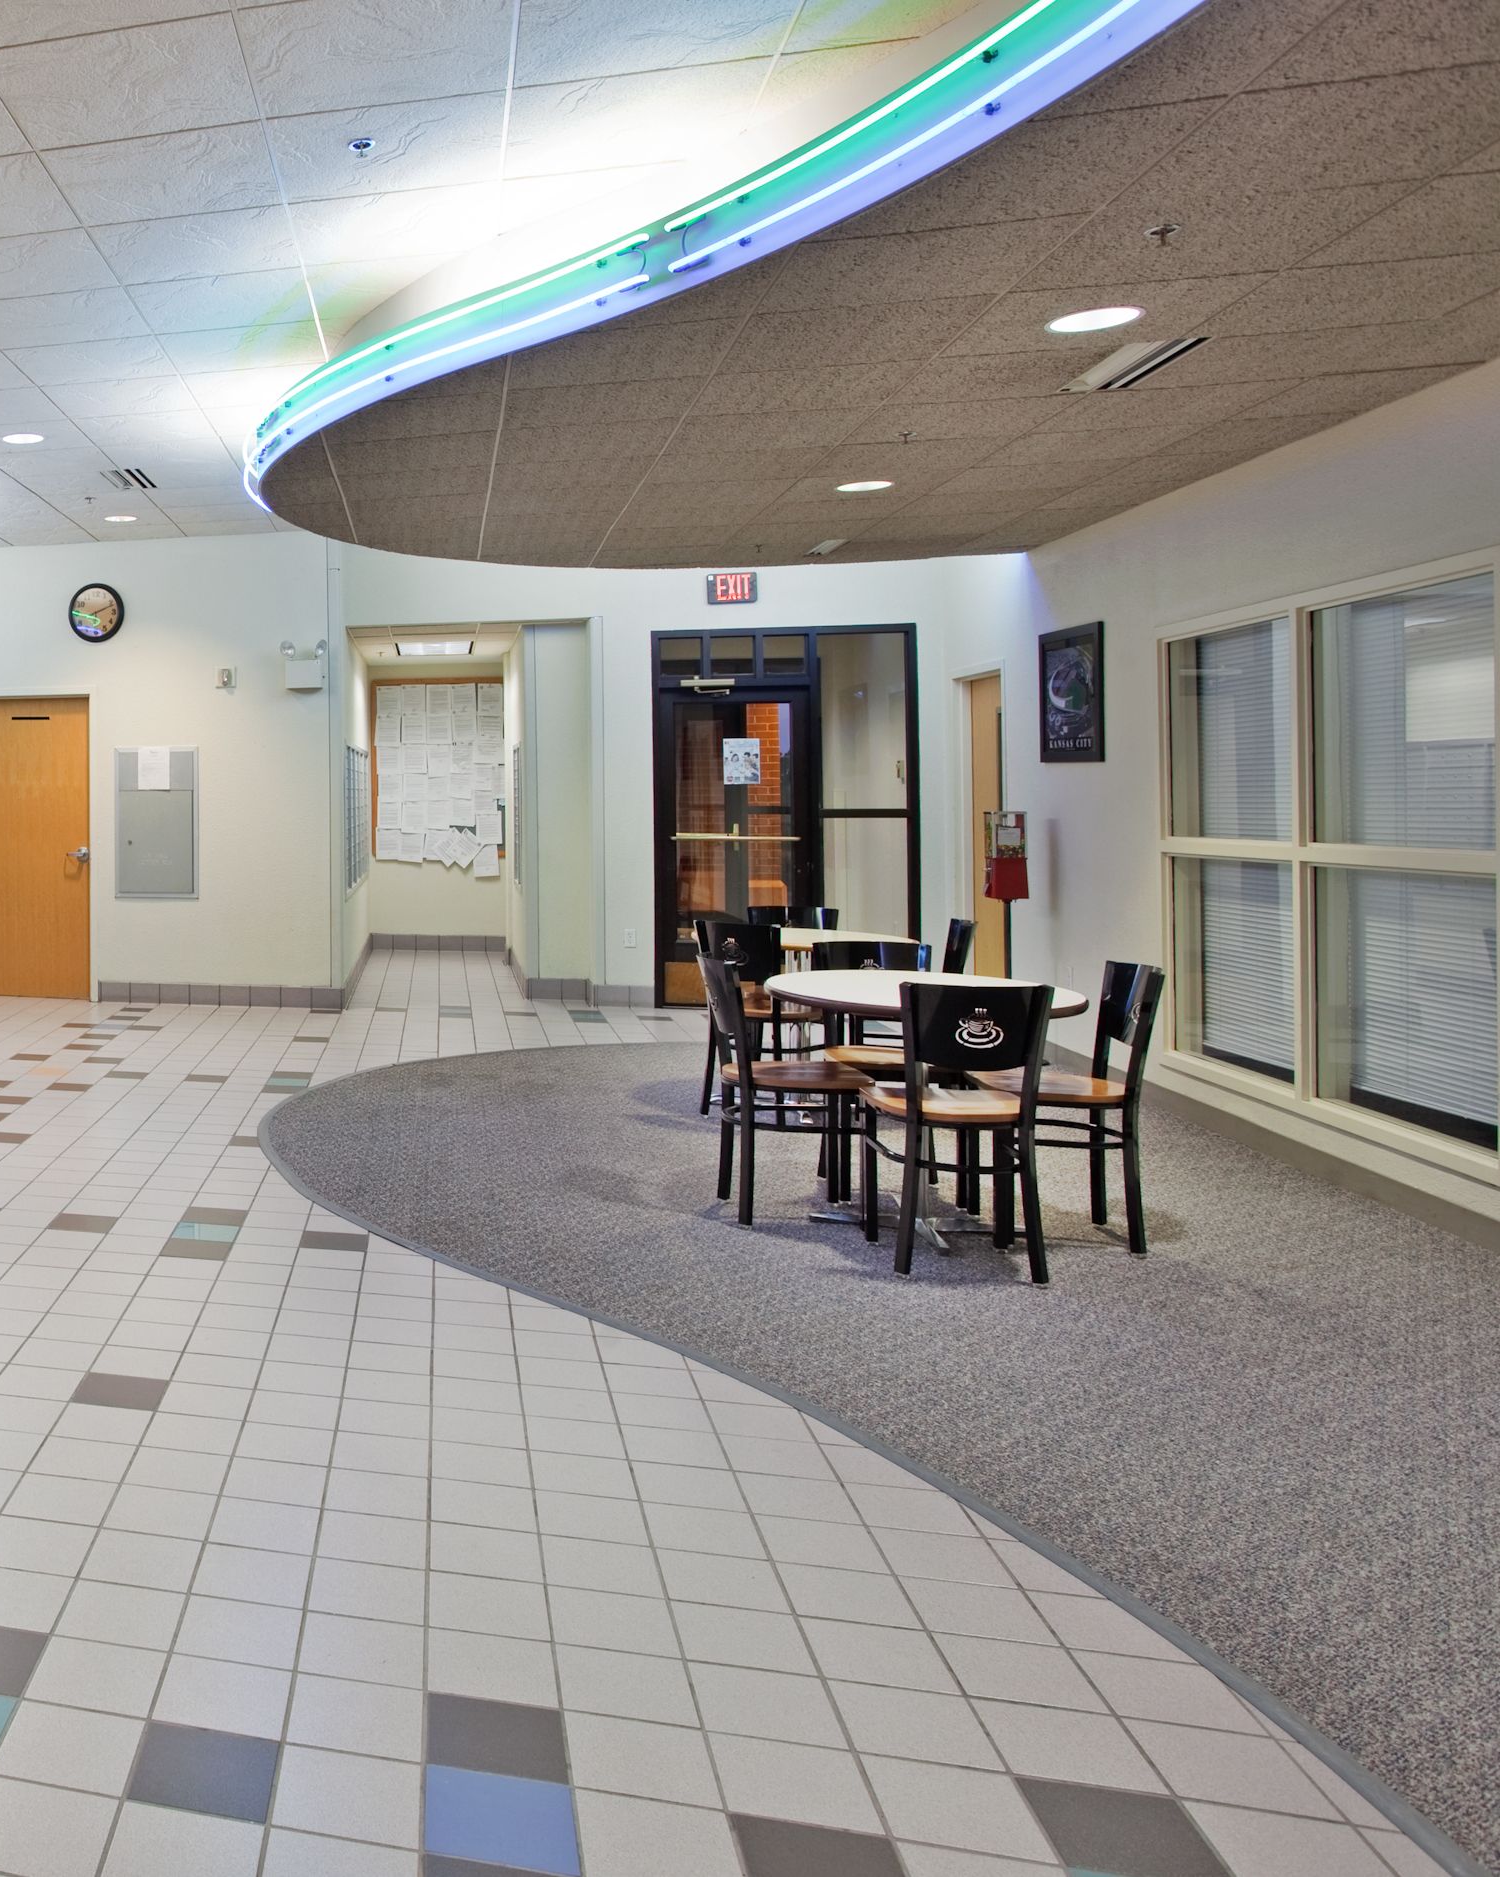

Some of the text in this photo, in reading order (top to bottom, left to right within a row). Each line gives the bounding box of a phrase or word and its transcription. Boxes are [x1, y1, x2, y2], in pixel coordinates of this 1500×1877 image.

[715, 574, 751, 601] EXIT
[1049, 738, 1092, 749] KANSAS CITY
